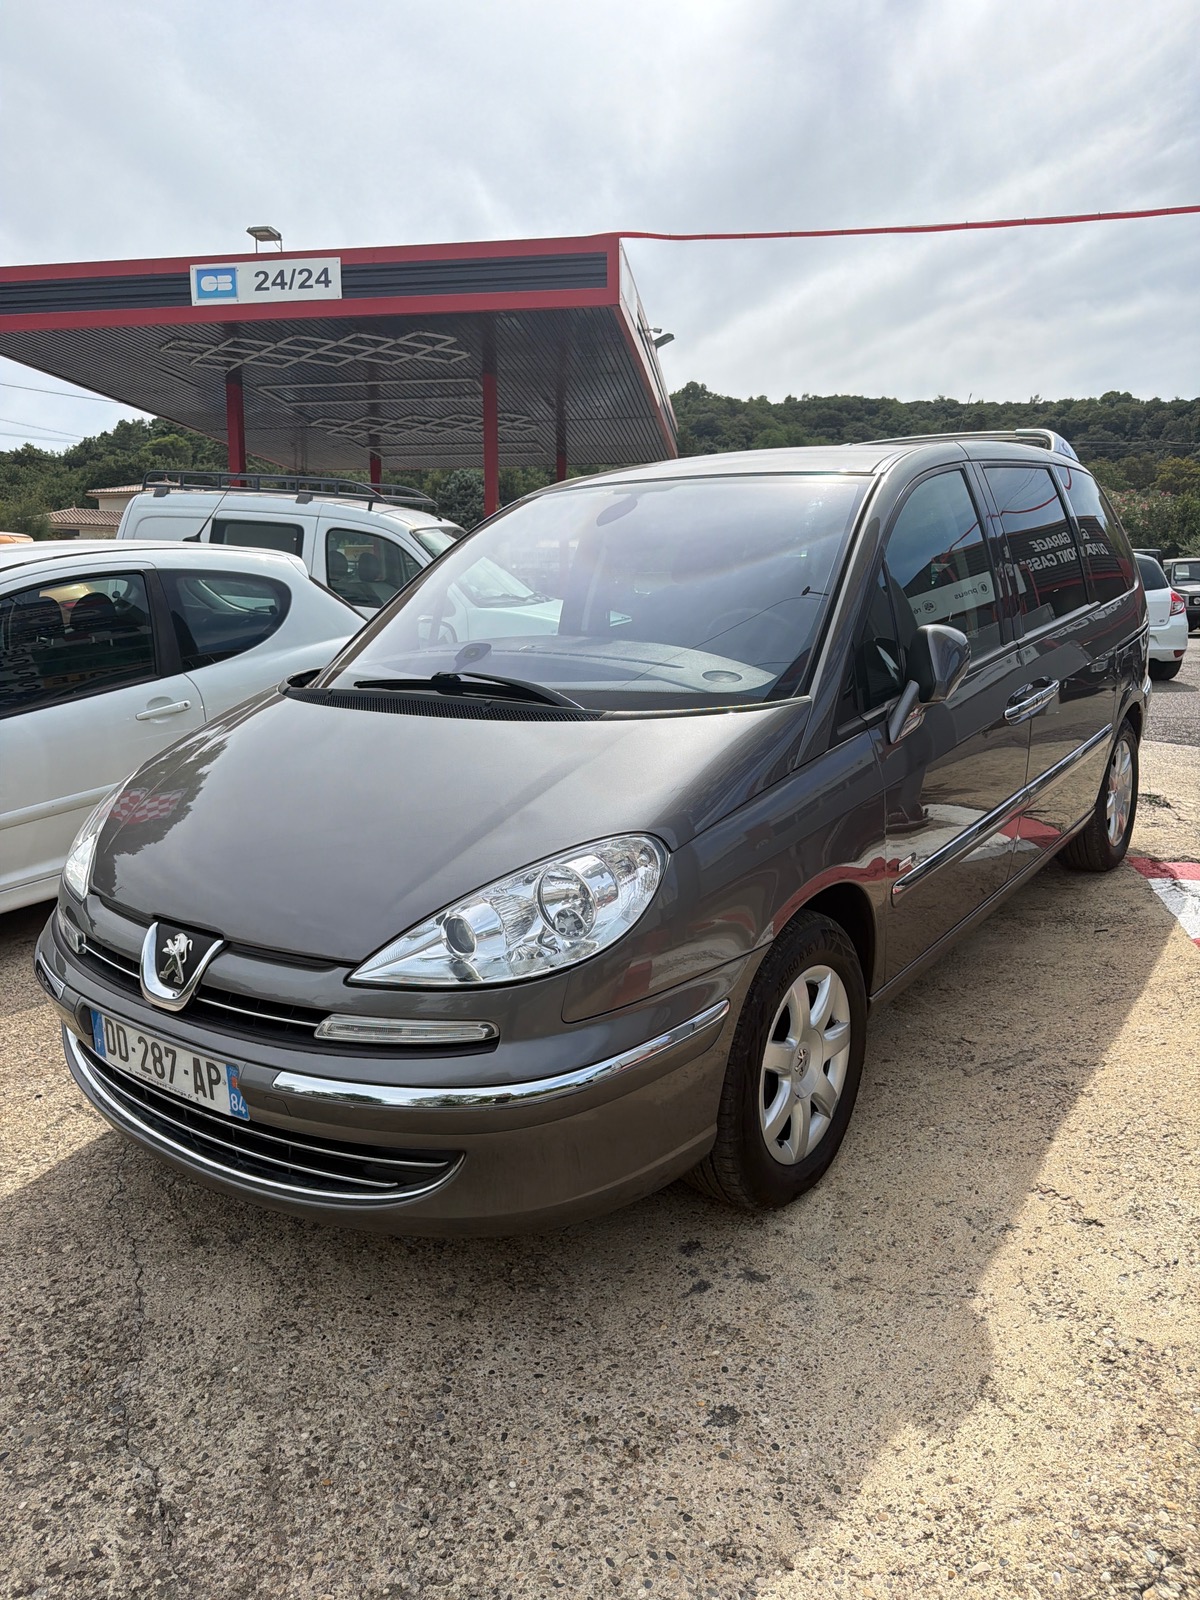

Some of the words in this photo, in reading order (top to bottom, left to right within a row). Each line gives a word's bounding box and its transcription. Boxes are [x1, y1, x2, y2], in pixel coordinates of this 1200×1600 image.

[200, 275, 232, 292] CB
[254, 267, 332, 292] 24/24
[104, 1018, 222, 1100] DD-287-AP
[230, 1093, 247, 1115] 84
